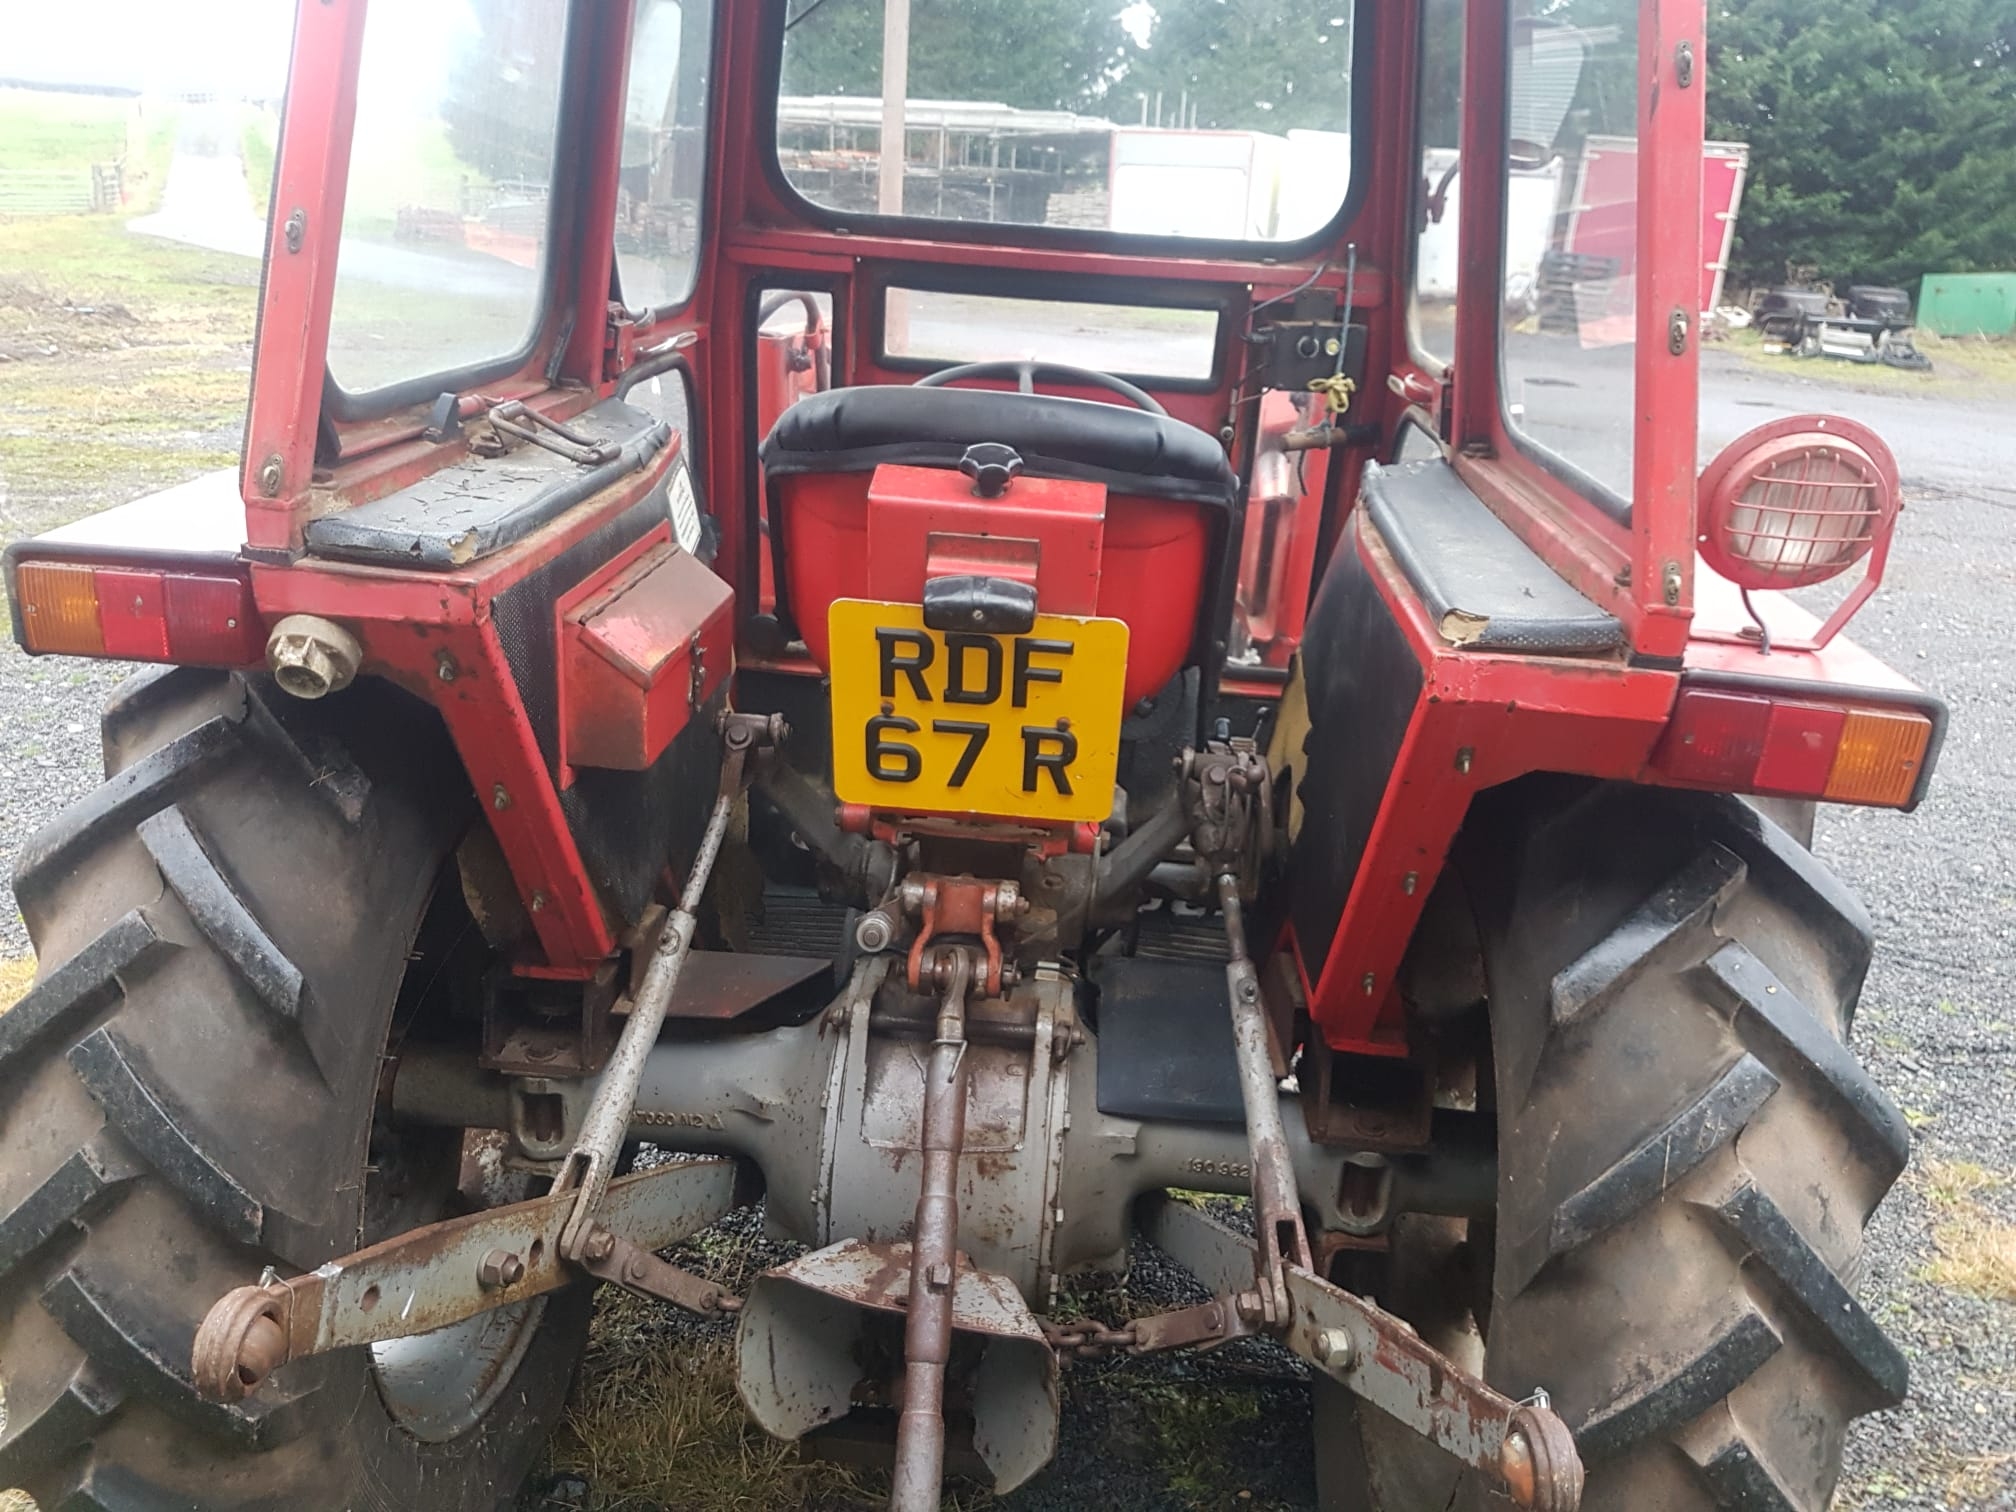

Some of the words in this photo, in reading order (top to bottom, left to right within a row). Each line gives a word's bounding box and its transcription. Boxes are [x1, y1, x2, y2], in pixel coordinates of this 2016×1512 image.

[875, 626, 1075, 708] RDF
[865, 715, 990, 788] 67
[1021, 725, 1078, 796] R
